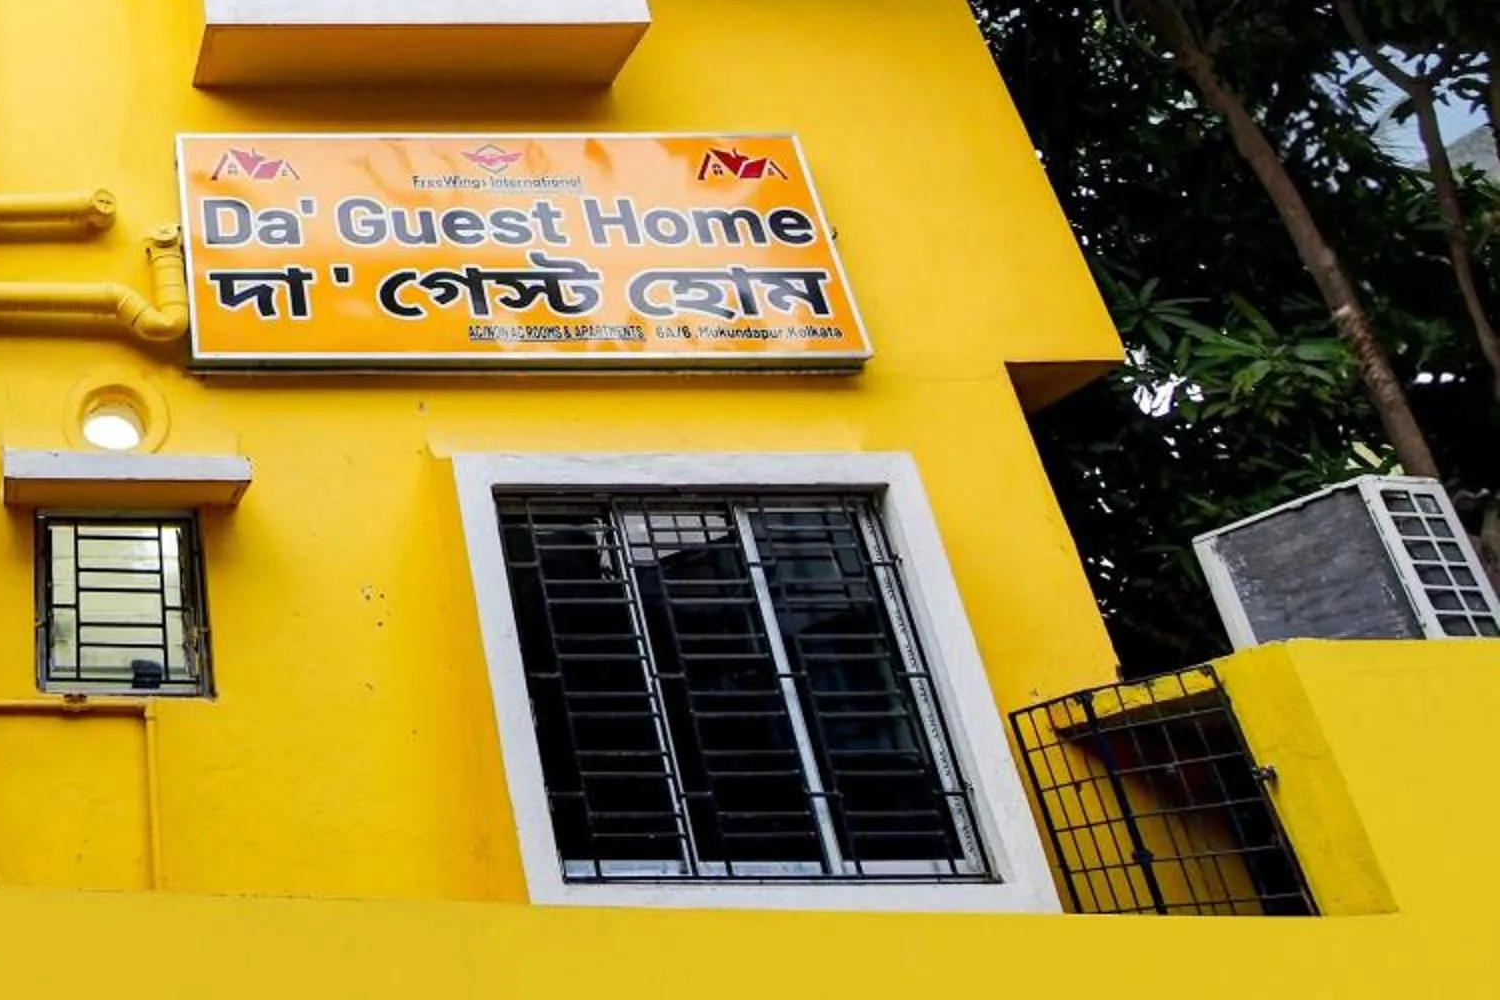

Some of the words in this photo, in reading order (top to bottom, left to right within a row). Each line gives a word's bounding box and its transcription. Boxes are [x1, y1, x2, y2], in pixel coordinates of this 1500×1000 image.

[202, 198, 314, 245] Da'
[336, 198, 568, 246] Guest
[582, 198, 814, 245] Home
[379, 251, 601, 317] গেস্ট
[628, 266, 830, 319] হোম
[563, 325, 572, 338] &
